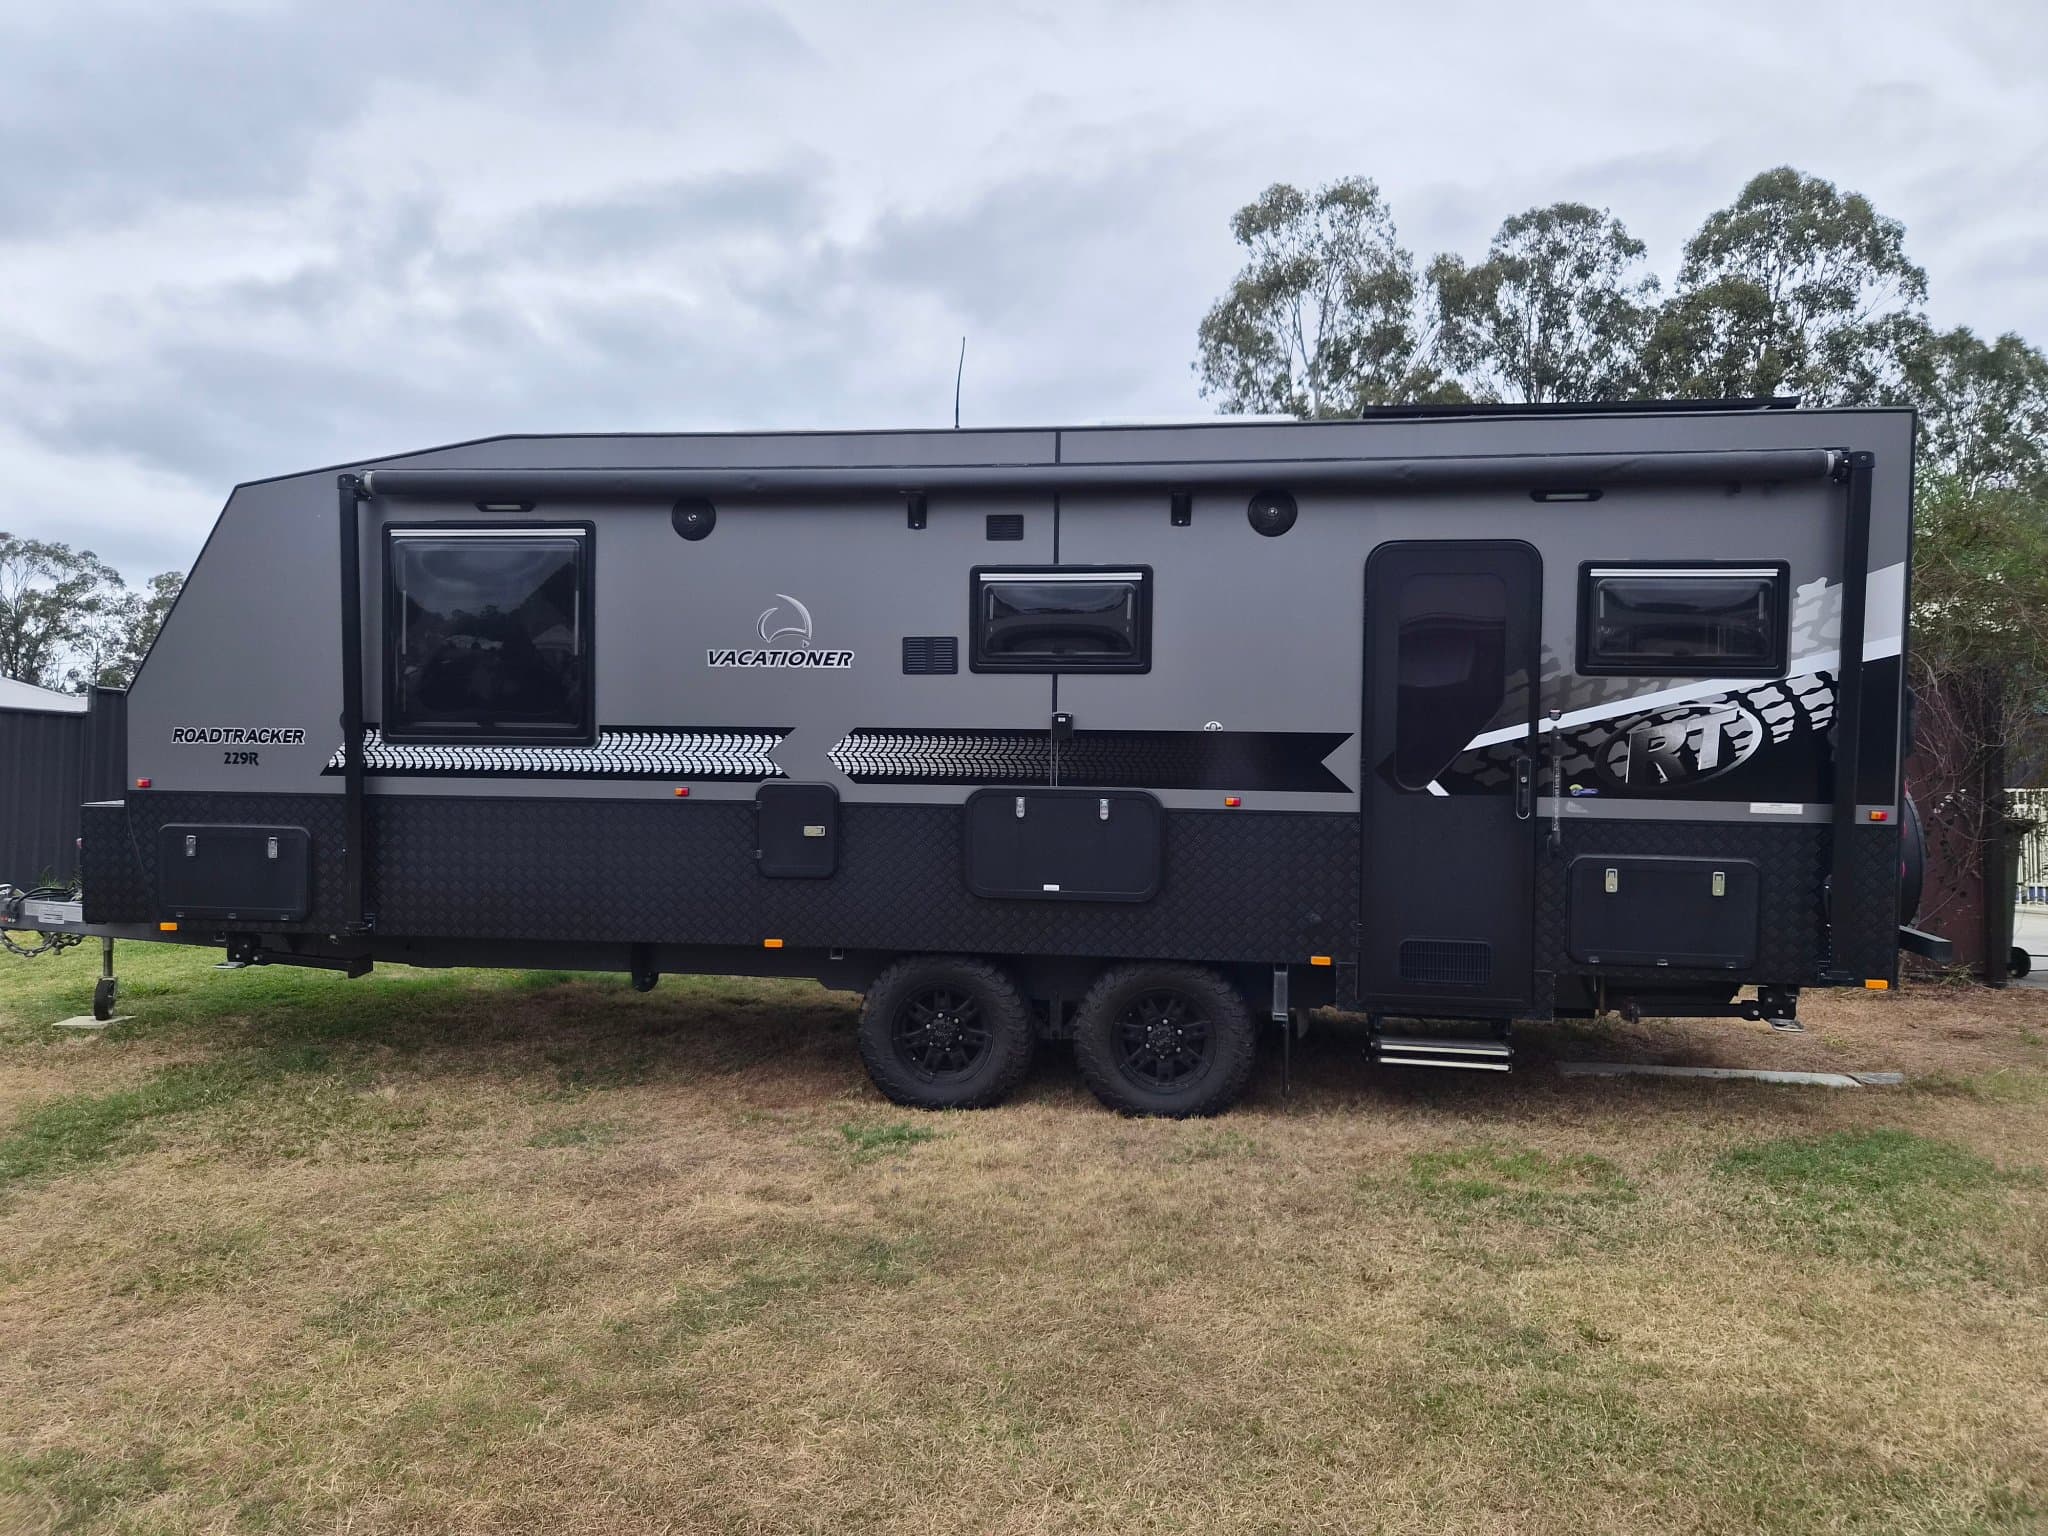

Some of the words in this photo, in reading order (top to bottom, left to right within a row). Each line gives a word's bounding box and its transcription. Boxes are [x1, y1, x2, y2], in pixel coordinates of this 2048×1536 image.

[708, 651, 854, 667] VACATIONER
[172, 727, 305, 745] ROADTRACKER
[1625, 707, 1740, 785] RT
[224, 752, 259, 766] 229R
